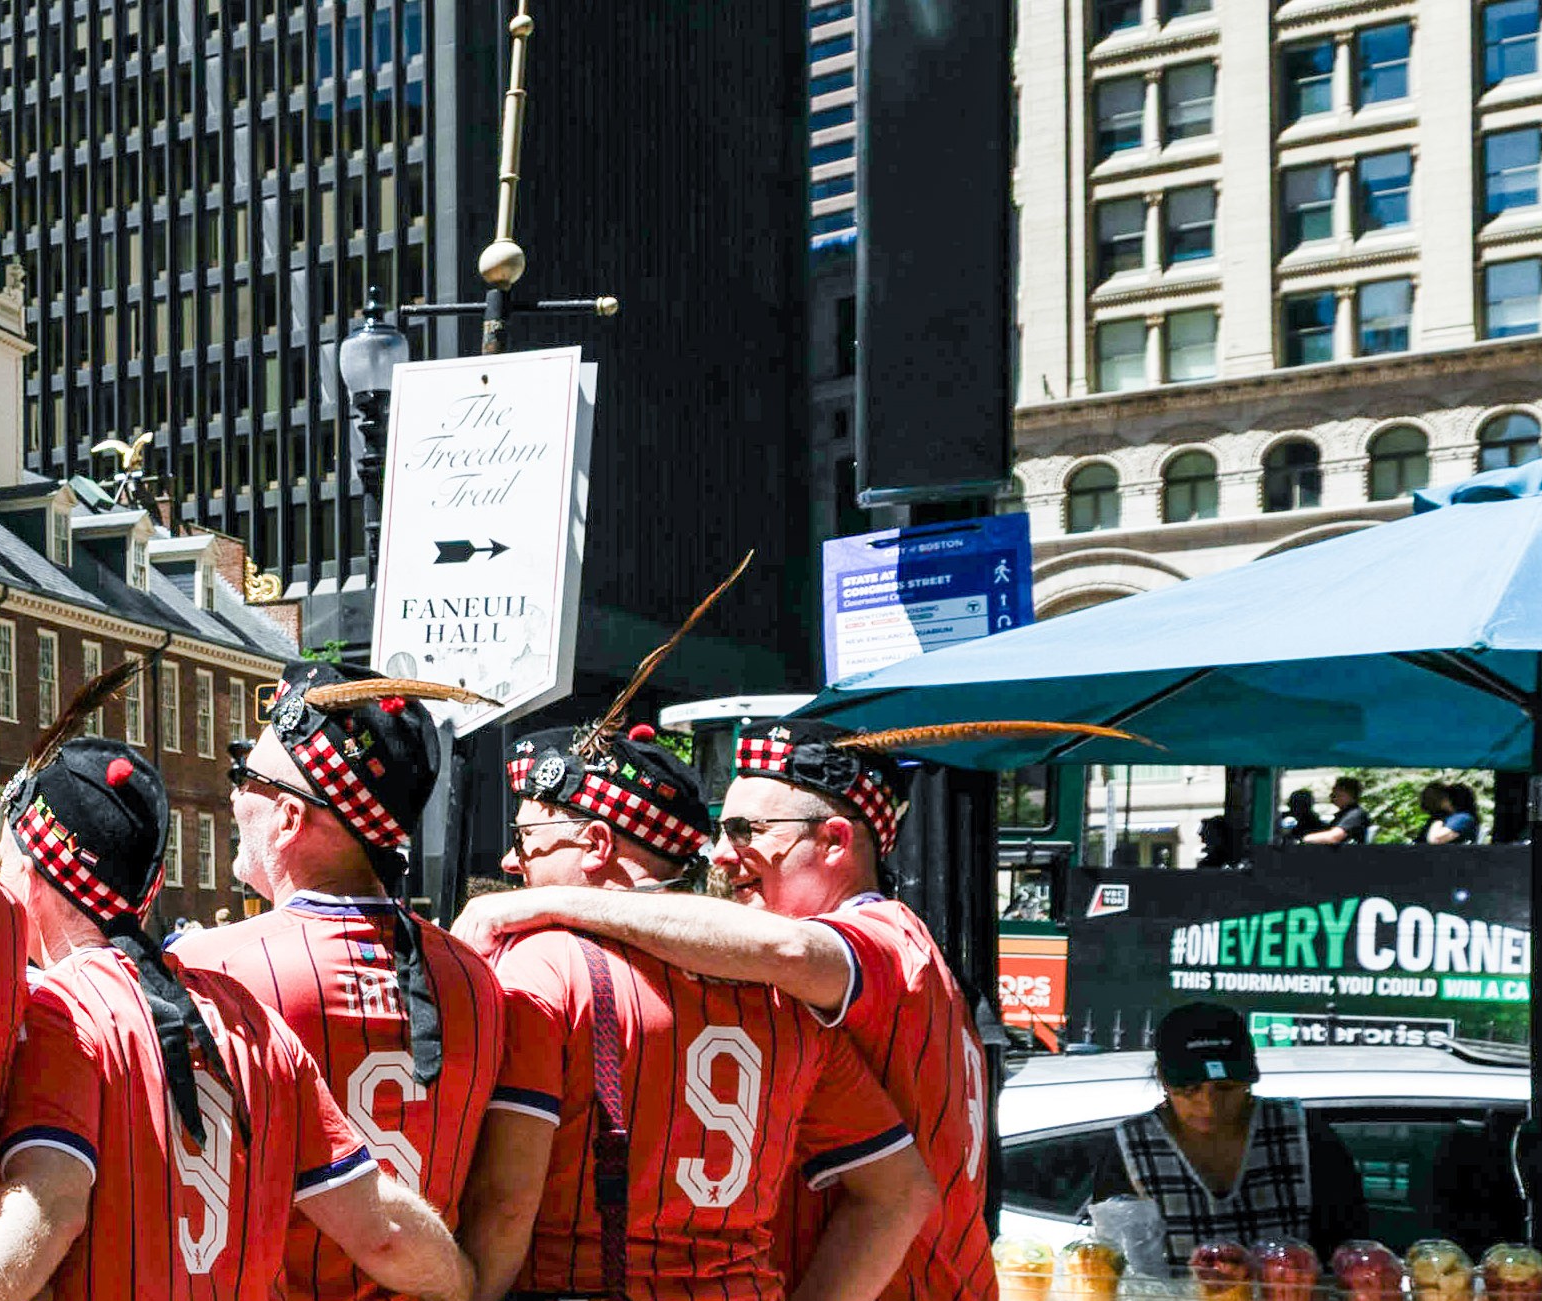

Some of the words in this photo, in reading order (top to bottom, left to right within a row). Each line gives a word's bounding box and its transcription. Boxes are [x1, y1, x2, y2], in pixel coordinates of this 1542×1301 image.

[442, 393, 512, 430] The
[405, 429, 548, 470] Freedom
[431, 470, 521, 508] Trail
[918, 539, 964, 553] BOSTON
[842, 572, 879, 587] STATE
[880, 569, 898, 581] AT
[842, 581, 906, 599] CONGRESS
[907, 574, 953, 589] STREET
[845, 610, 896, 622] DOWNTOWN
[424, 622, 508, 644] HALL
[908, 626, 953, 637] AQUARIUM
[1169, 971, 1211, 989] THIS
[1214, 972, 1335, 995] TOURNAMENT,
[1337, 976, 1374, 996] YOU
[1376, 978, 1437, 997] COULD
[1442, 979, 1482, 998] WIN
[1484, 980, 1500, 998] A
[675, 1025, 762, 1208] 9
